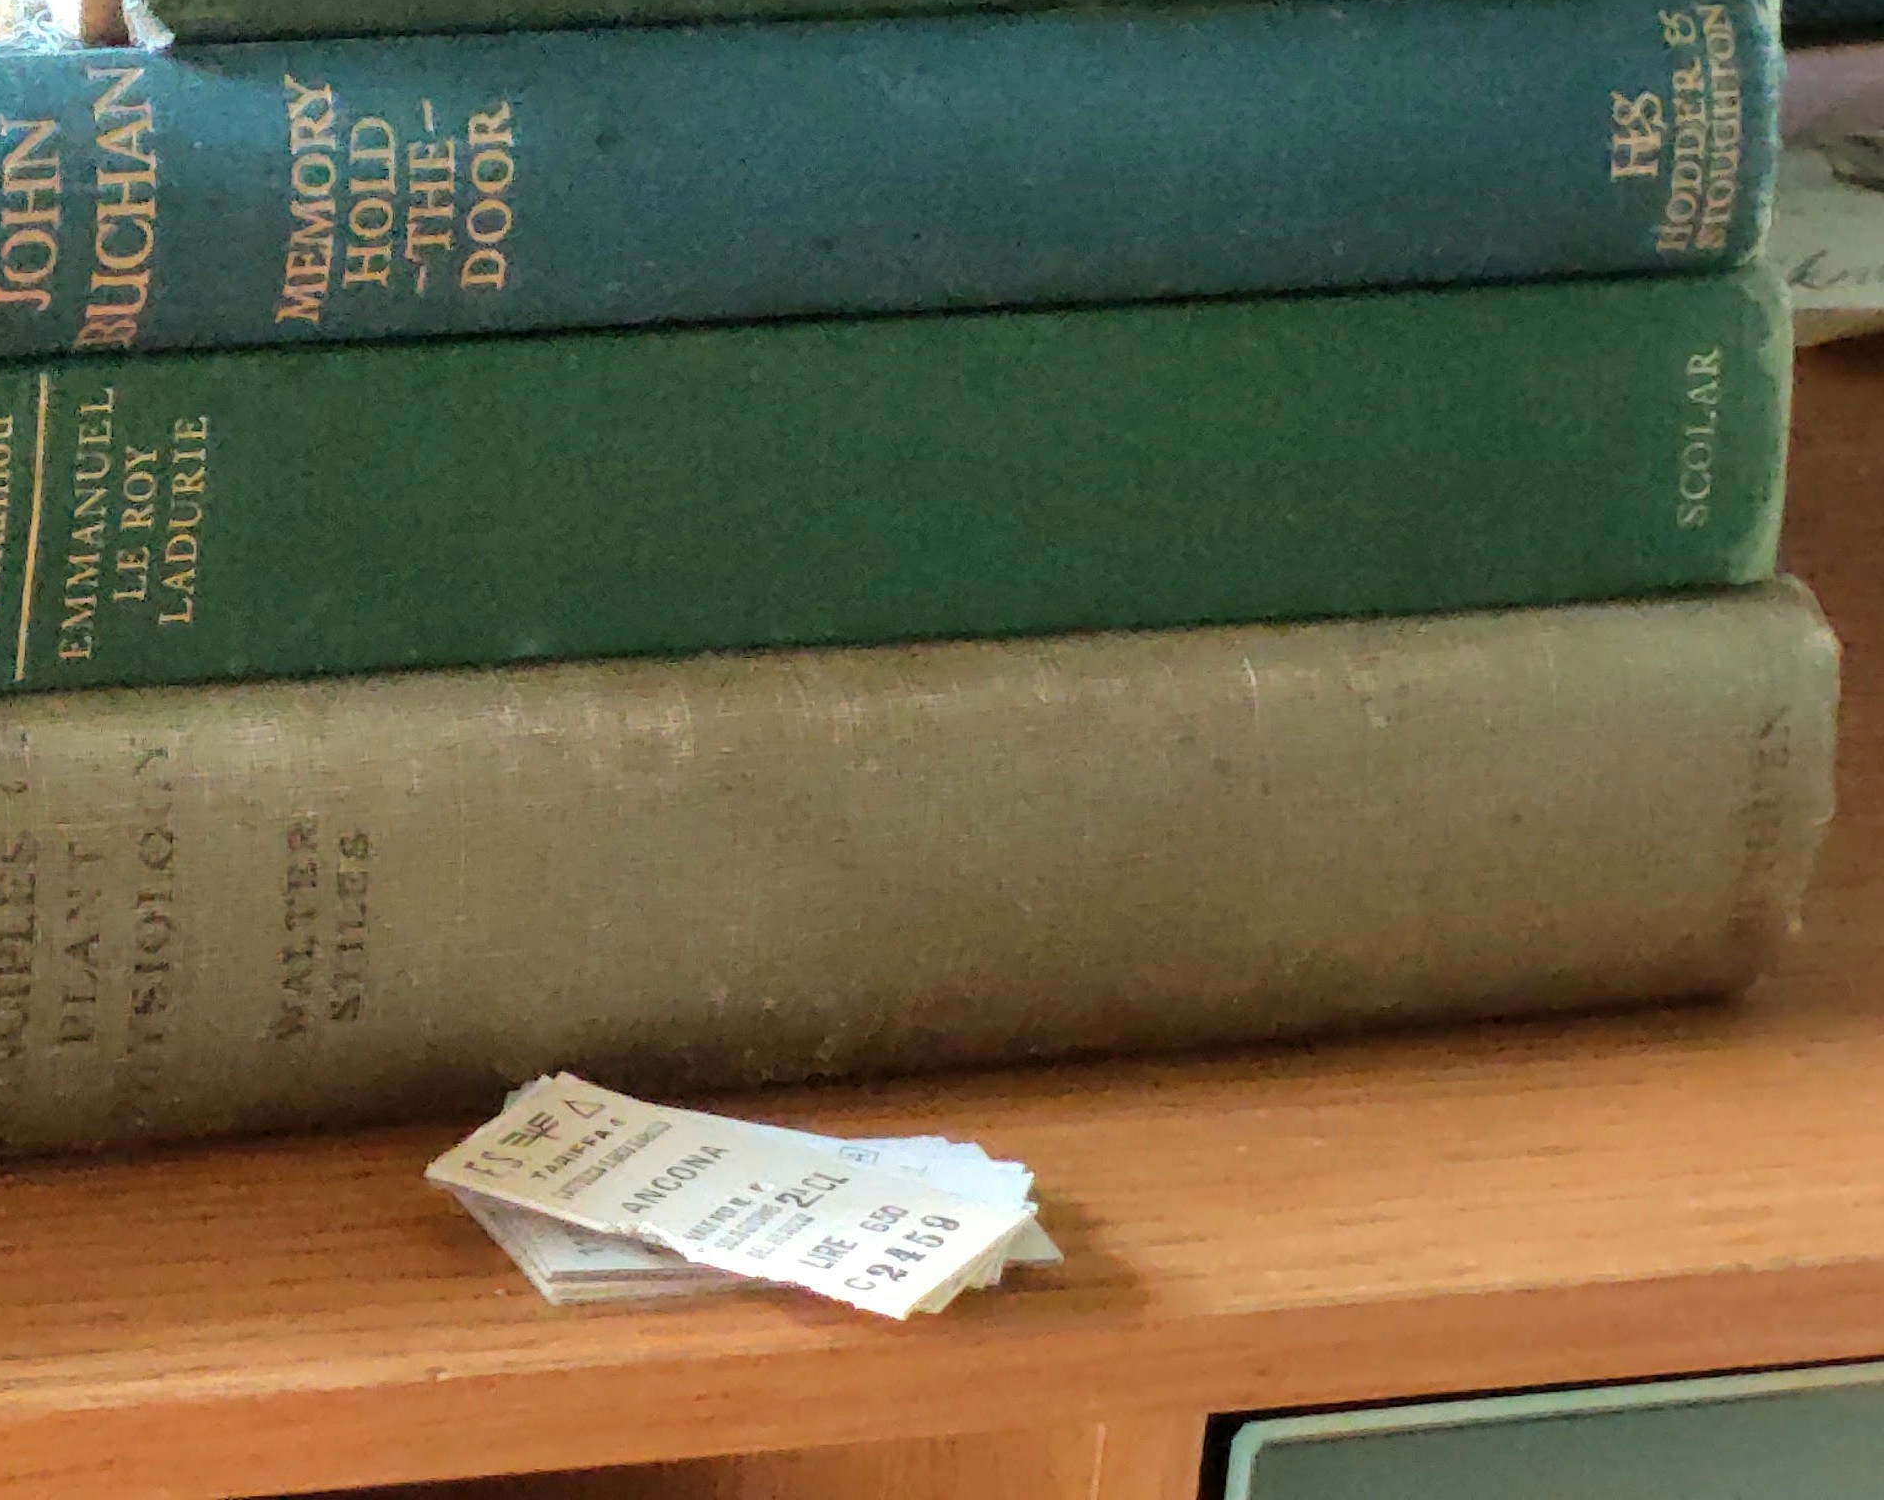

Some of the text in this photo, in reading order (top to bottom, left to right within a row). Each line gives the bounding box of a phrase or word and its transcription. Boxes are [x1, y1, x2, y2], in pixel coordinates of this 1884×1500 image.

[74, 66, 158, 348] BUCHAN
[277, 74, 337, 321] MEMORY
[344, 115, 399, 287] HOLD
[461, 102, 514, 289] DOOR
[1656, 8, 1706, 251] HODDER &
[1695, 3, 1742, 250] STOUGHTON
[59, 386, 116, 661] EMMANUEL
[113, 446, 158, 602] LE ROY
[158, 416, 208, 625] LADURIE
[1676, 346, 1722, 530] SCOLAR
[621, 1145, 730, 1214] ANCONA
[798, 1235, 859, 1270] LIRE
[859, 1204, 910, 1233] 650
